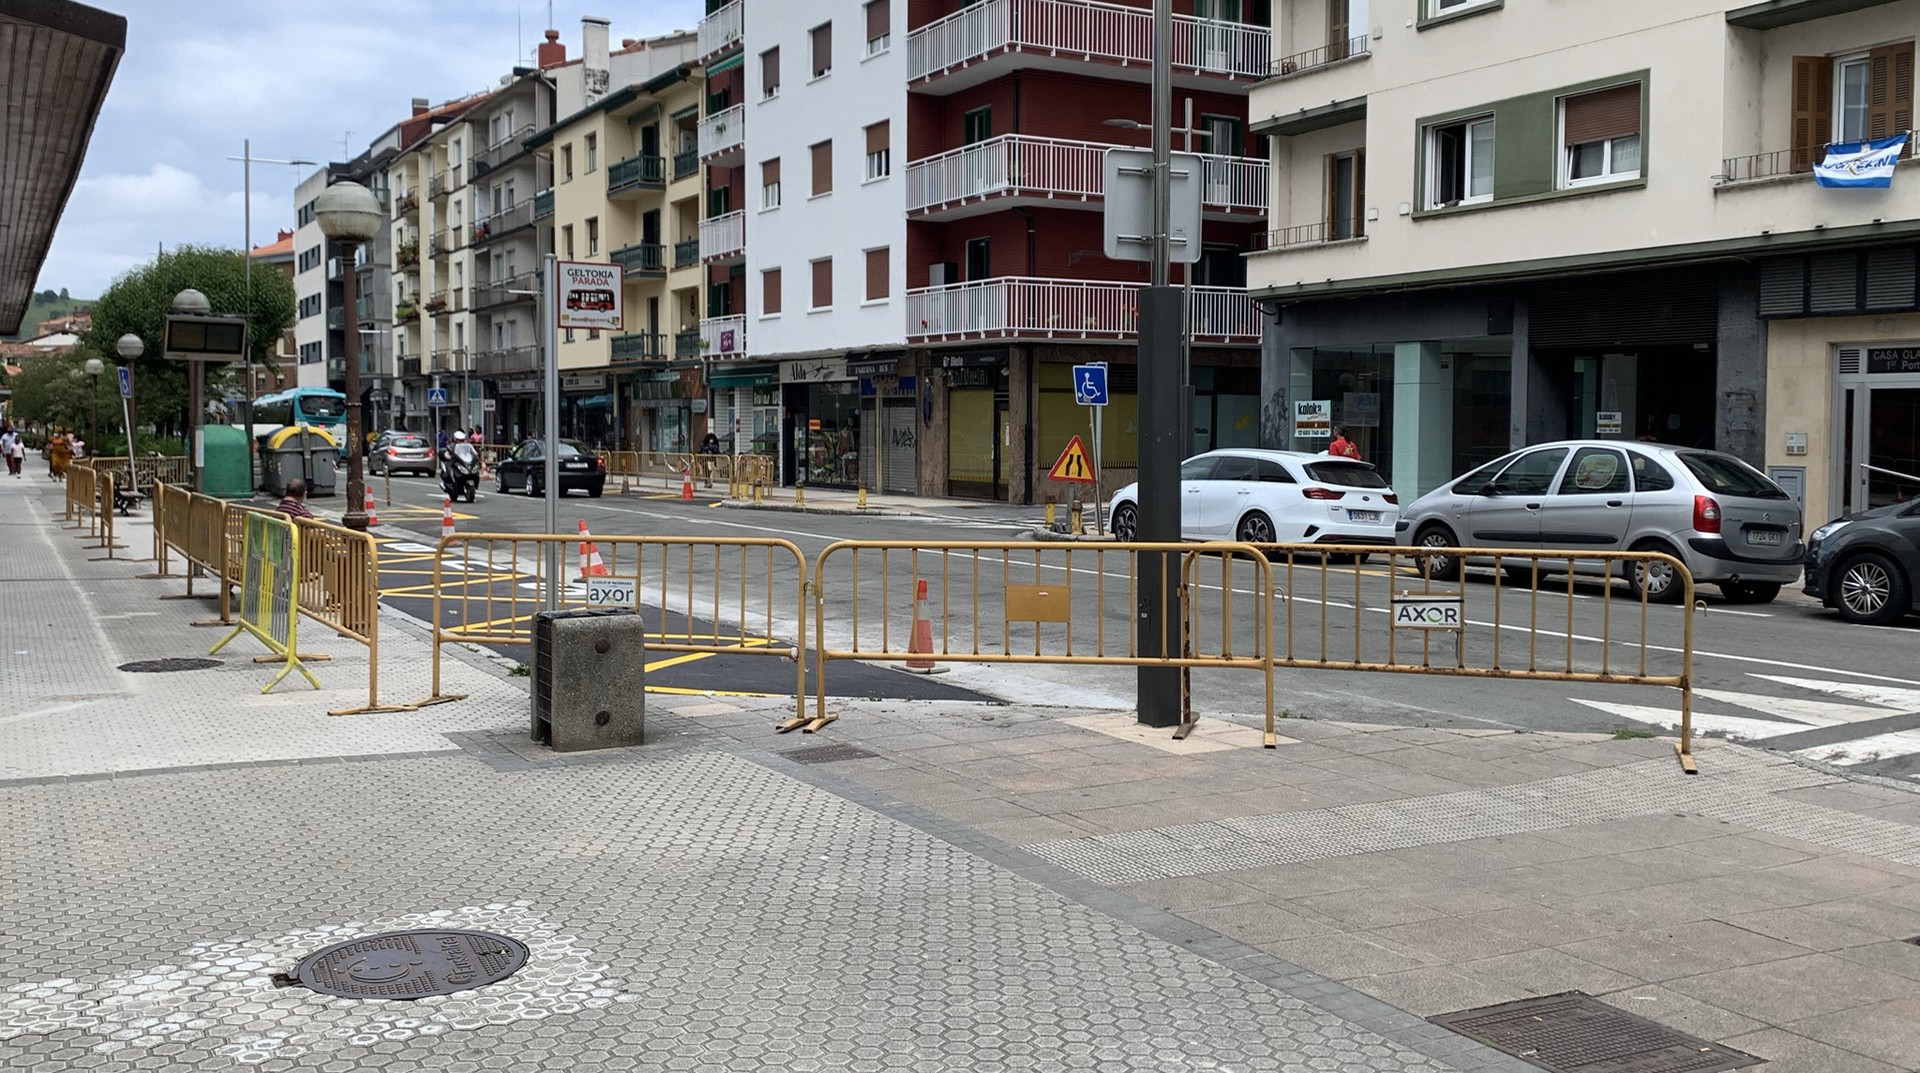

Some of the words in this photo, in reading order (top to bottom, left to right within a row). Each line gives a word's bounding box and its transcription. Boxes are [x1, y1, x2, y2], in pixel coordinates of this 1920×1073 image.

[567, 268, 614, 278] GELTOKIA
[572, 277, 609, 286] PARADA
[1873, 350, 1899, 360] CASA
[855, 365, 875, 374] TABERNA
[589, 587, 634, 605] axor
[1397, 605, 1458, 624] AXOR
